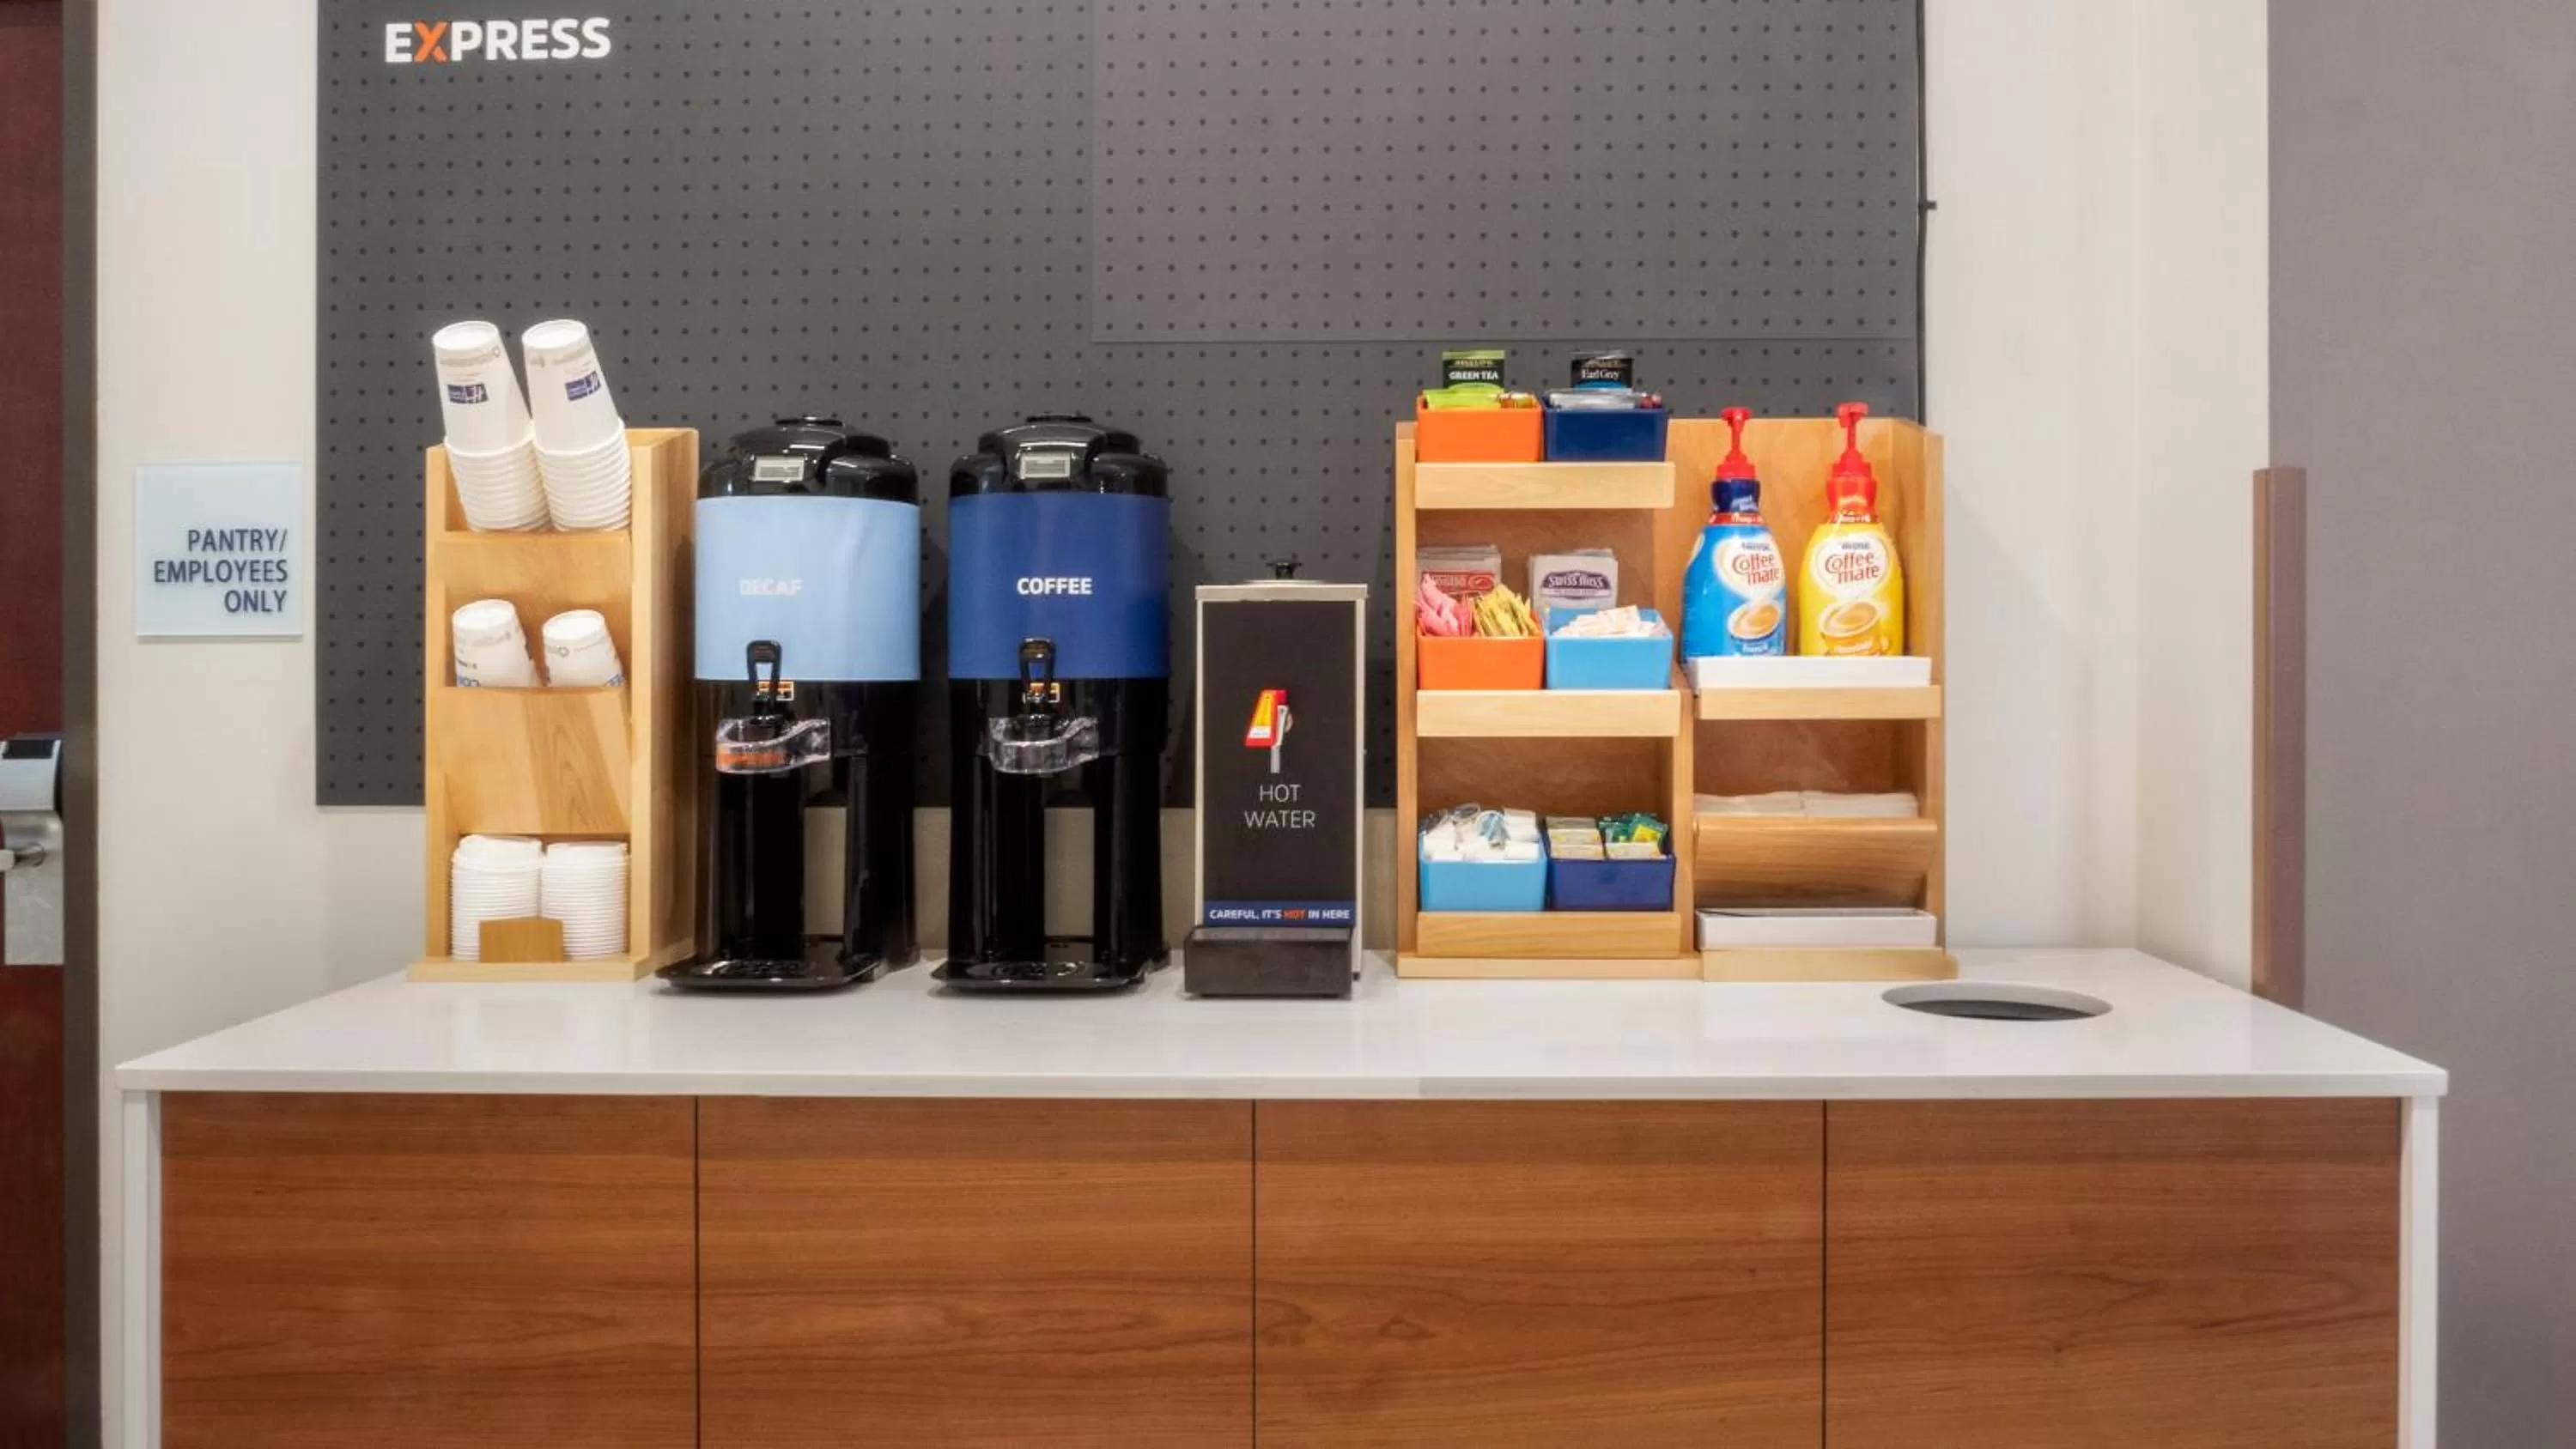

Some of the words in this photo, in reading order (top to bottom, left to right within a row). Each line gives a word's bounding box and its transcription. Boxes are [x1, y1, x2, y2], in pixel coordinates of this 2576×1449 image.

[385, 17, 611, 63] EXPRESS
[1449, 370, 1479, 380] GREEN
[1480, 370, 1498, 380] TEA
[187, 528, 288, 552] PANTRY/
[153, 559, 288, 583] EMPLOYEES
[1732, 553, 1775, 575] Coffee
[1825, 552, 1875, 574] Coffee
[1747, 567, 1780, 585] mate
[1837, 565, 1880, 585] mate
[739, 579, 805, 596] DECAF
[1017, 577, 1093, 596] COFFEE
[224, 590, 287, 613] ONLY
[1259, 784, 1301, 803] HOT
[1244, 810, 1316, 828] WATER
[1209, 909, 1260, 921] CAREFUL,
[1261, 909, 1282, 919] IT'S
[1283, 909, 1306, 919] HOT
[1308, 909, 1320, 919] IN
[1322, 909, 1351, 919] HERE
